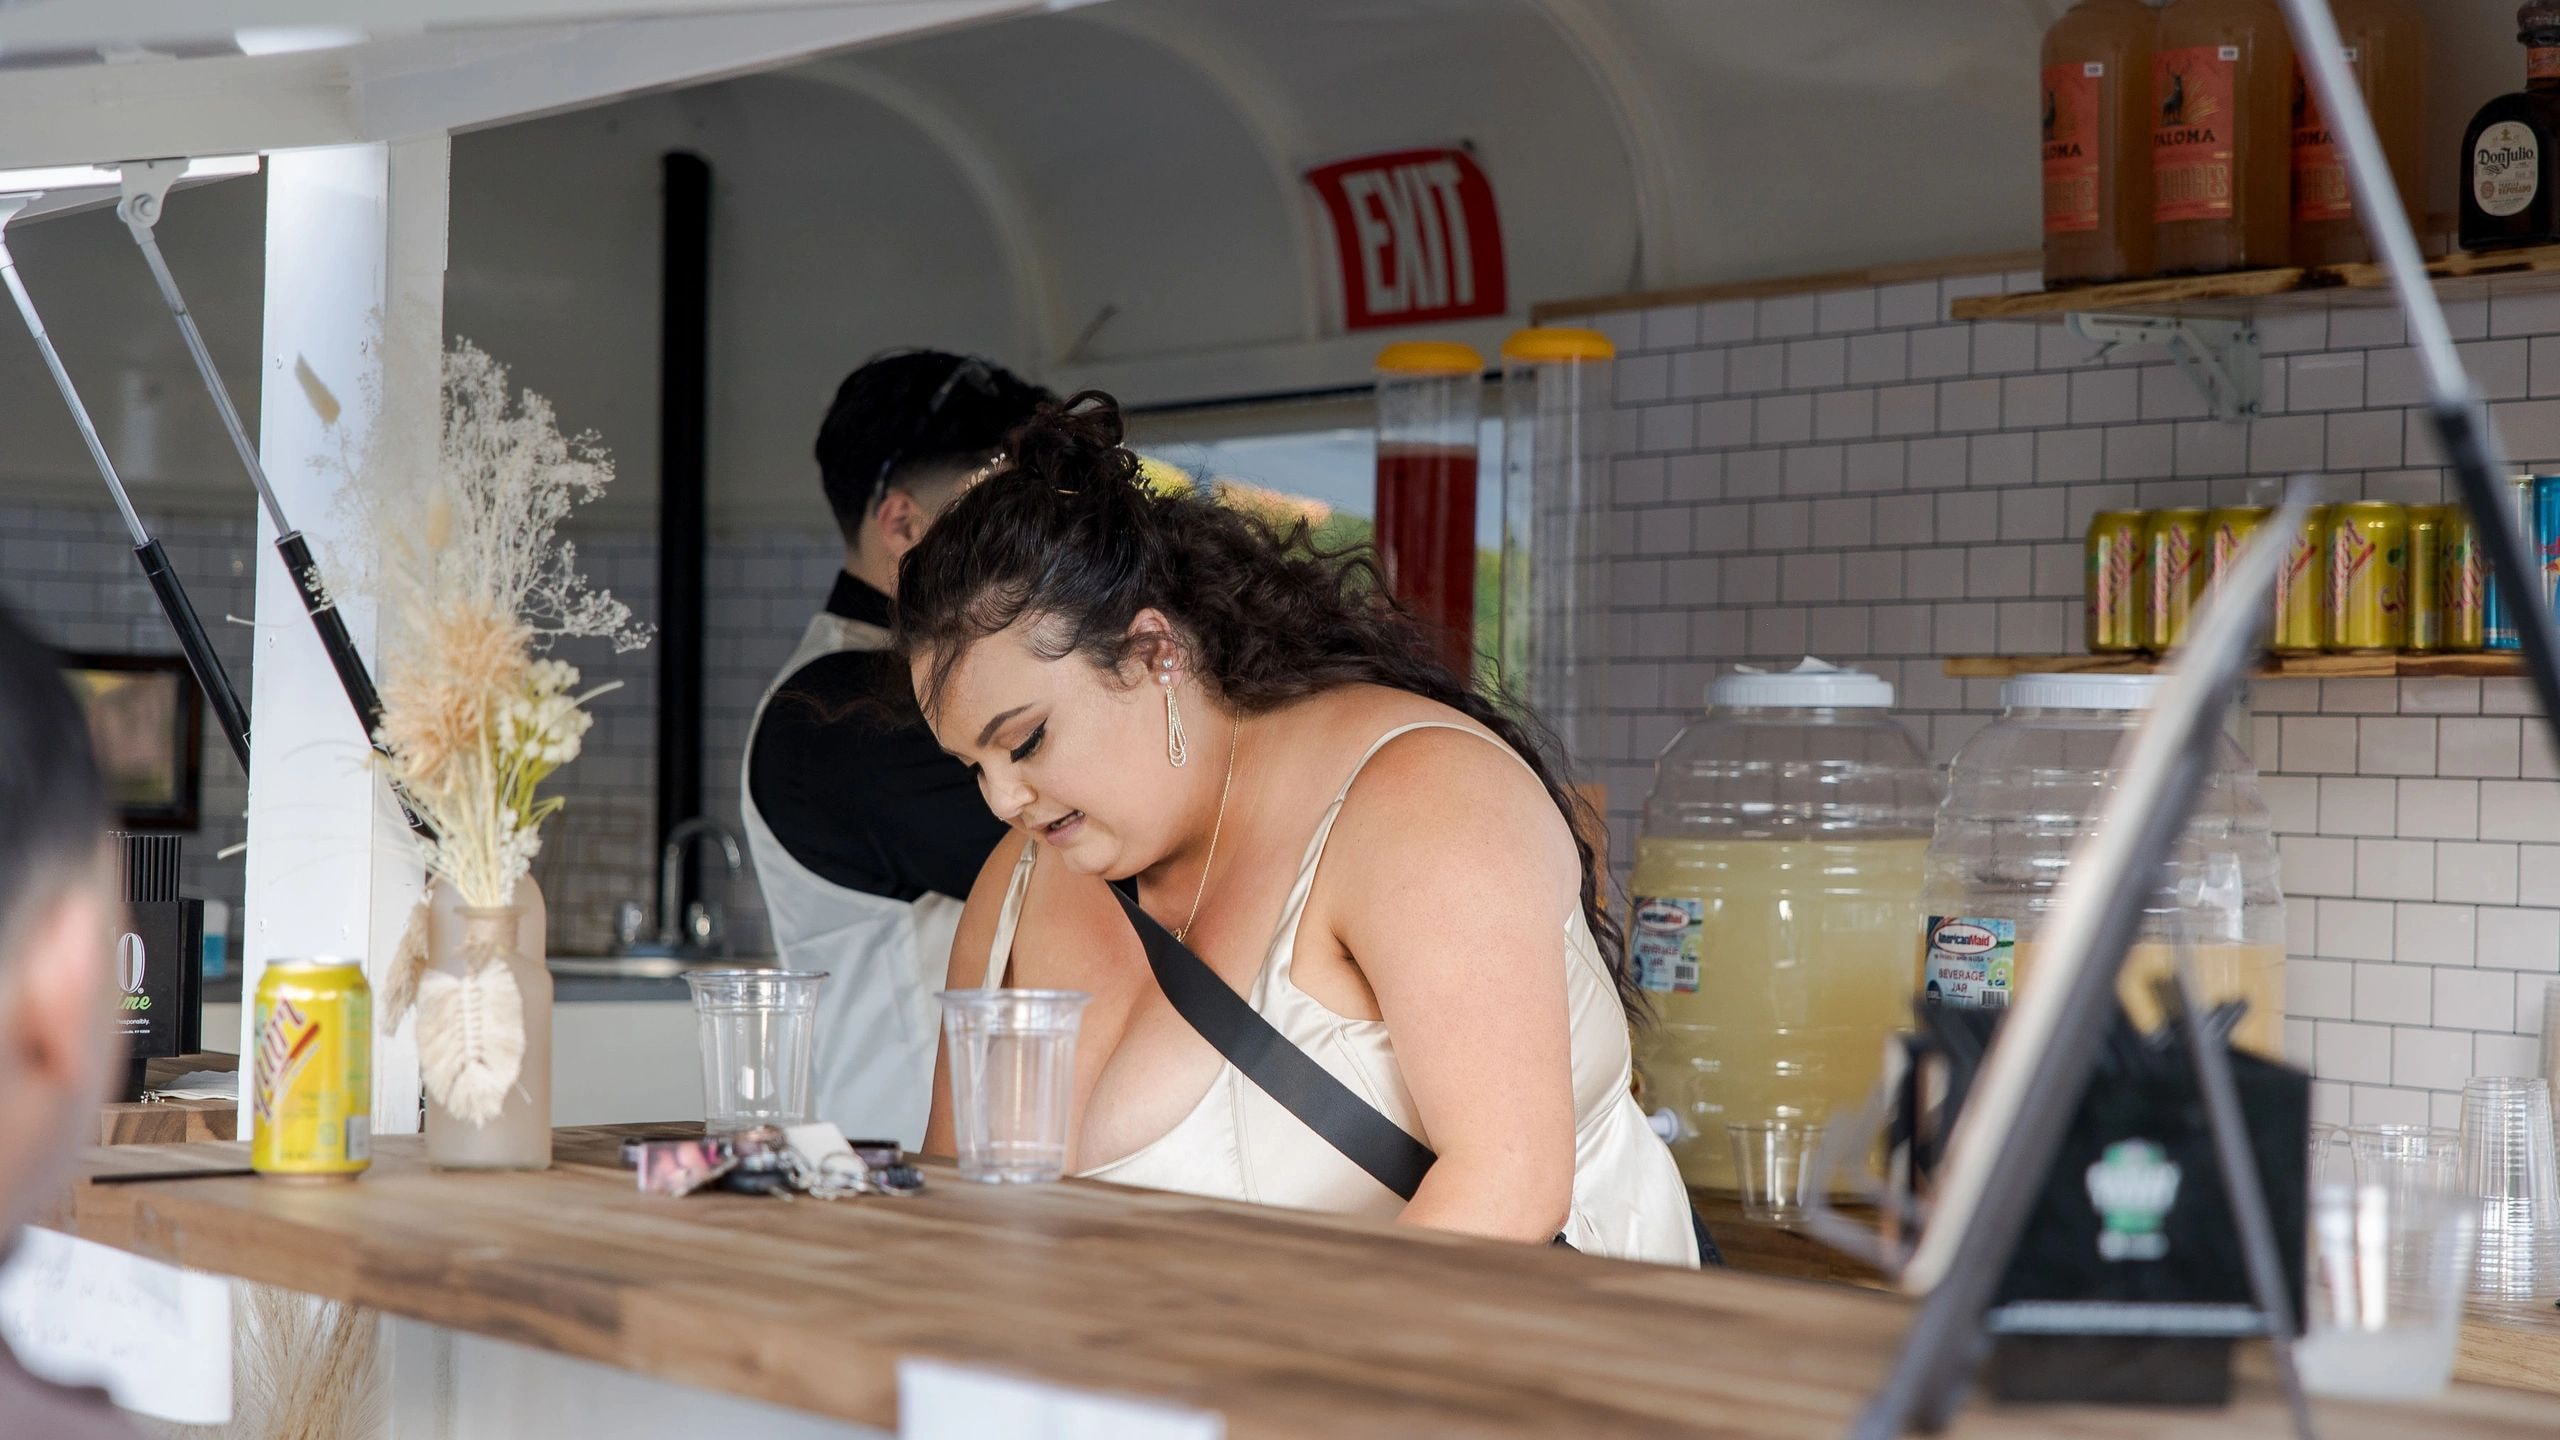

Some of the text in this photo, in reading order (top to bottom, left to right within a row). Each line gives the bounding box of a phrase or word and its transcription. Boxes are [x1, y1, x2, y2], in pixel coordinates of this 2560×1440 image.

[1338, 160, 1474, 316] EXIT
[1938, 967, 1986, 981] BEVERAGE
[1951, 982, 1968, 993] JAR
